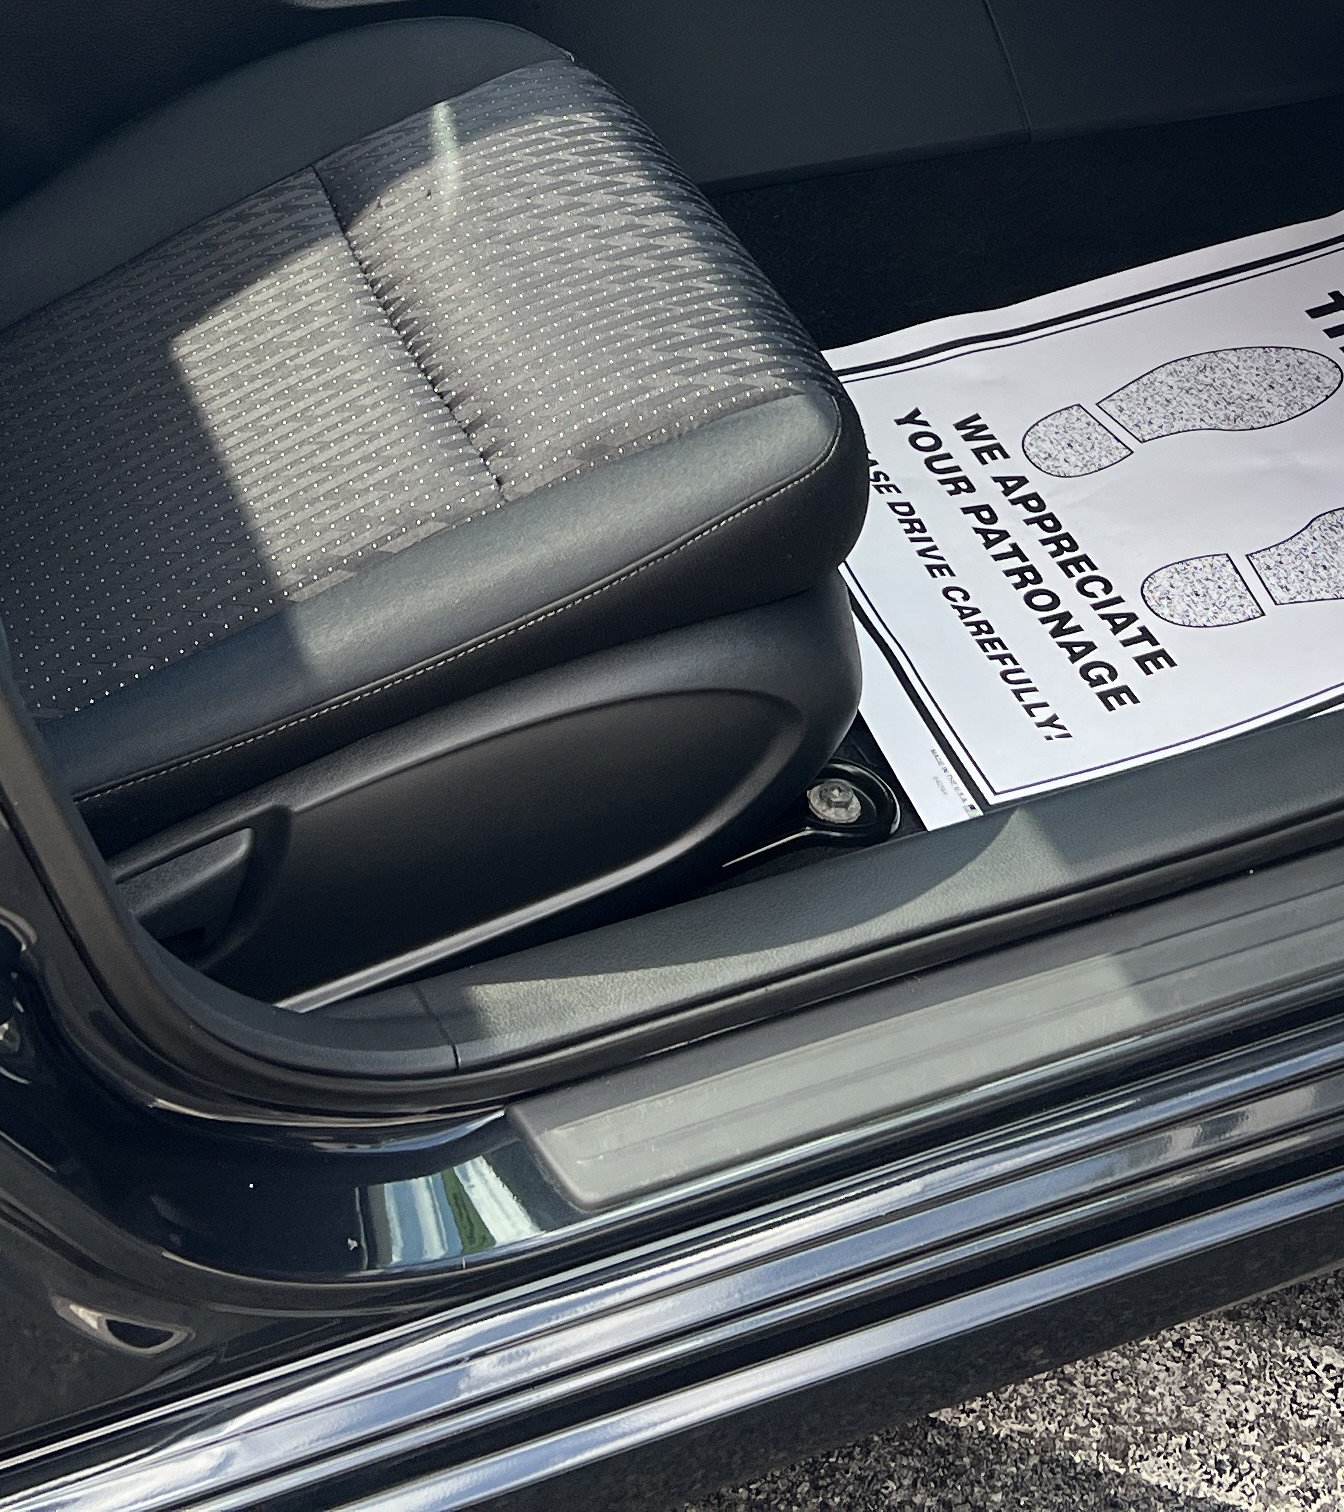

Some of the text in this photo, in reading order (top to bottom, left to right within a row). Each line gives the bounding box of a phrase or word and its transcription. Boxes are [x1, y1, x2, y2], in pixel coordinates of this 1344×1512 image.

[886, 501, 957, 579] DRIVE
[941, 586, 1073, 741] CAREFULLY!
[893, 406, 1141, 712] YOUR PATRONAGE
[952, 412, 1178, 676] WE APPRECIATE
